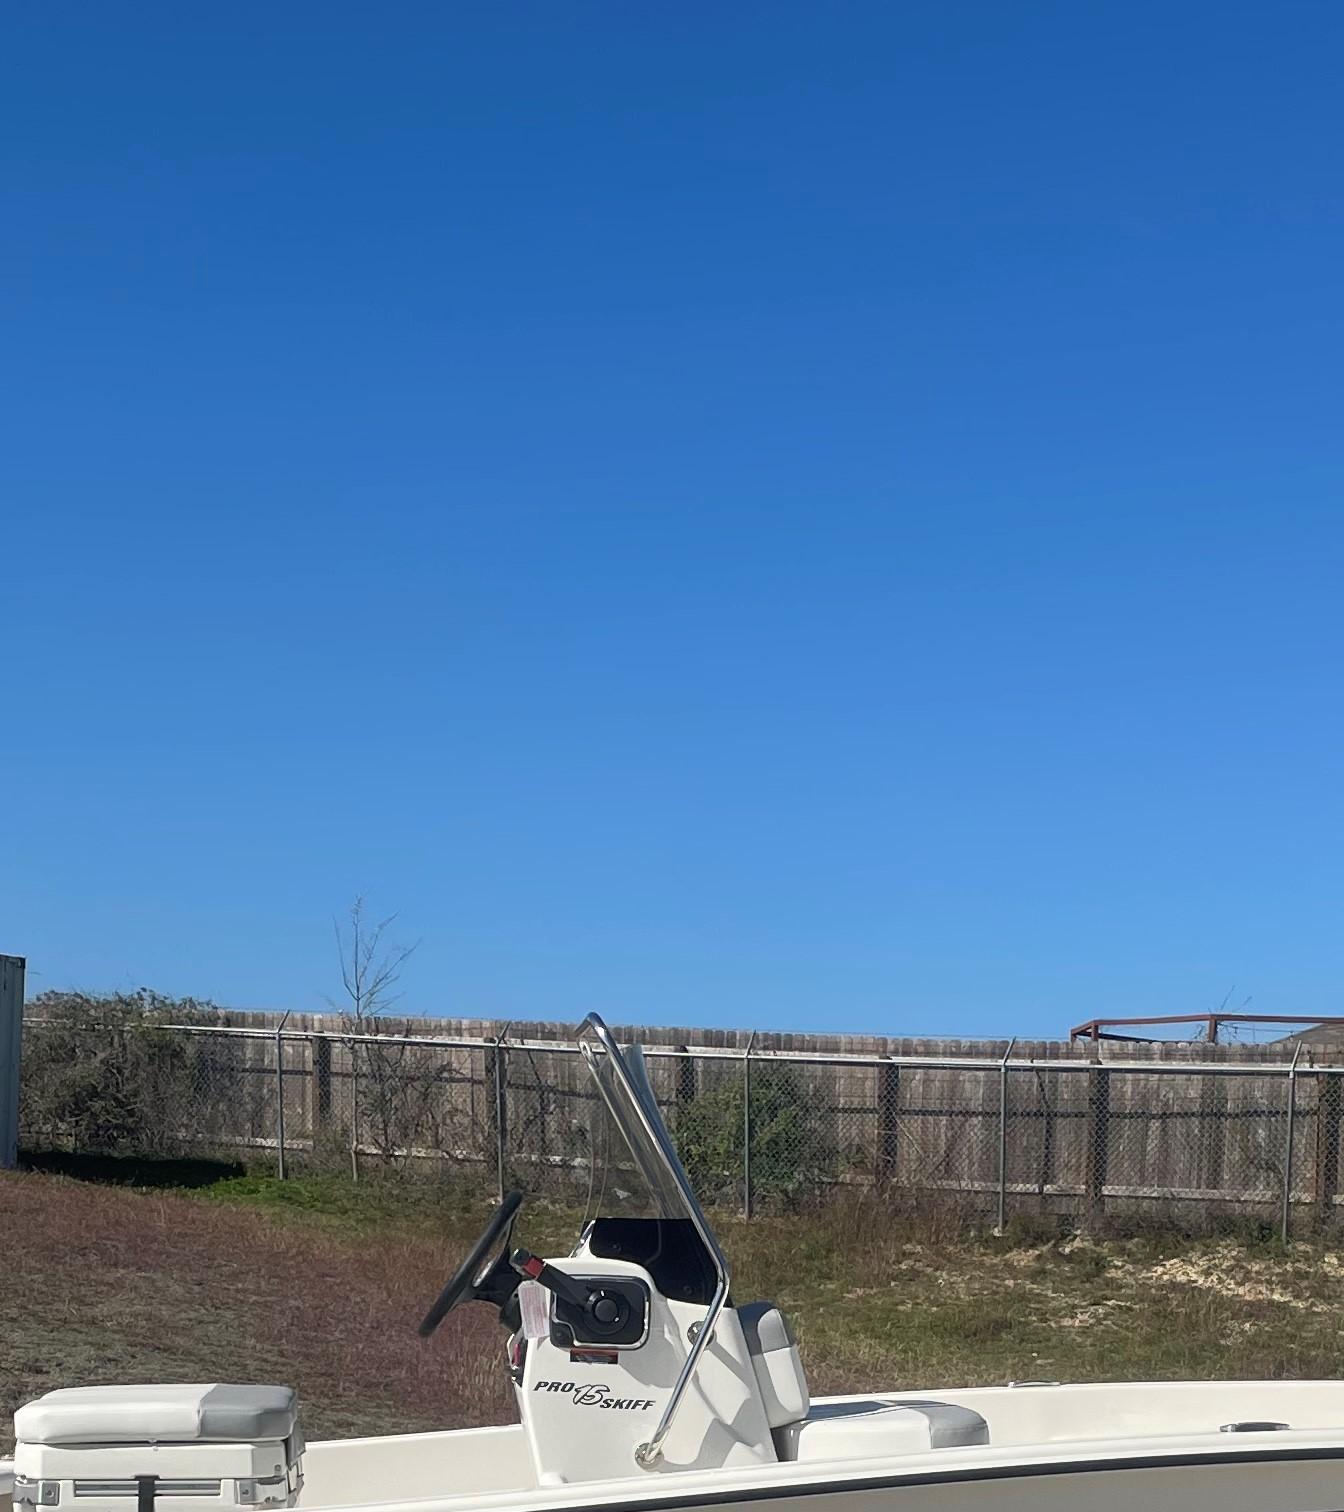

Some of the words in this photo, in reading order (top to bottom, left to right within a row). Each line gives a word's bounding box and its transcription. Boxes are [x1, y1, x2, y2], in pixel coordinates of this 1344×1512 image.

[533, 1381, 575, 1393] PRO
[572, 1384, 610, 1406] 15
[599, 1398, 656, 1411] SKIFF
